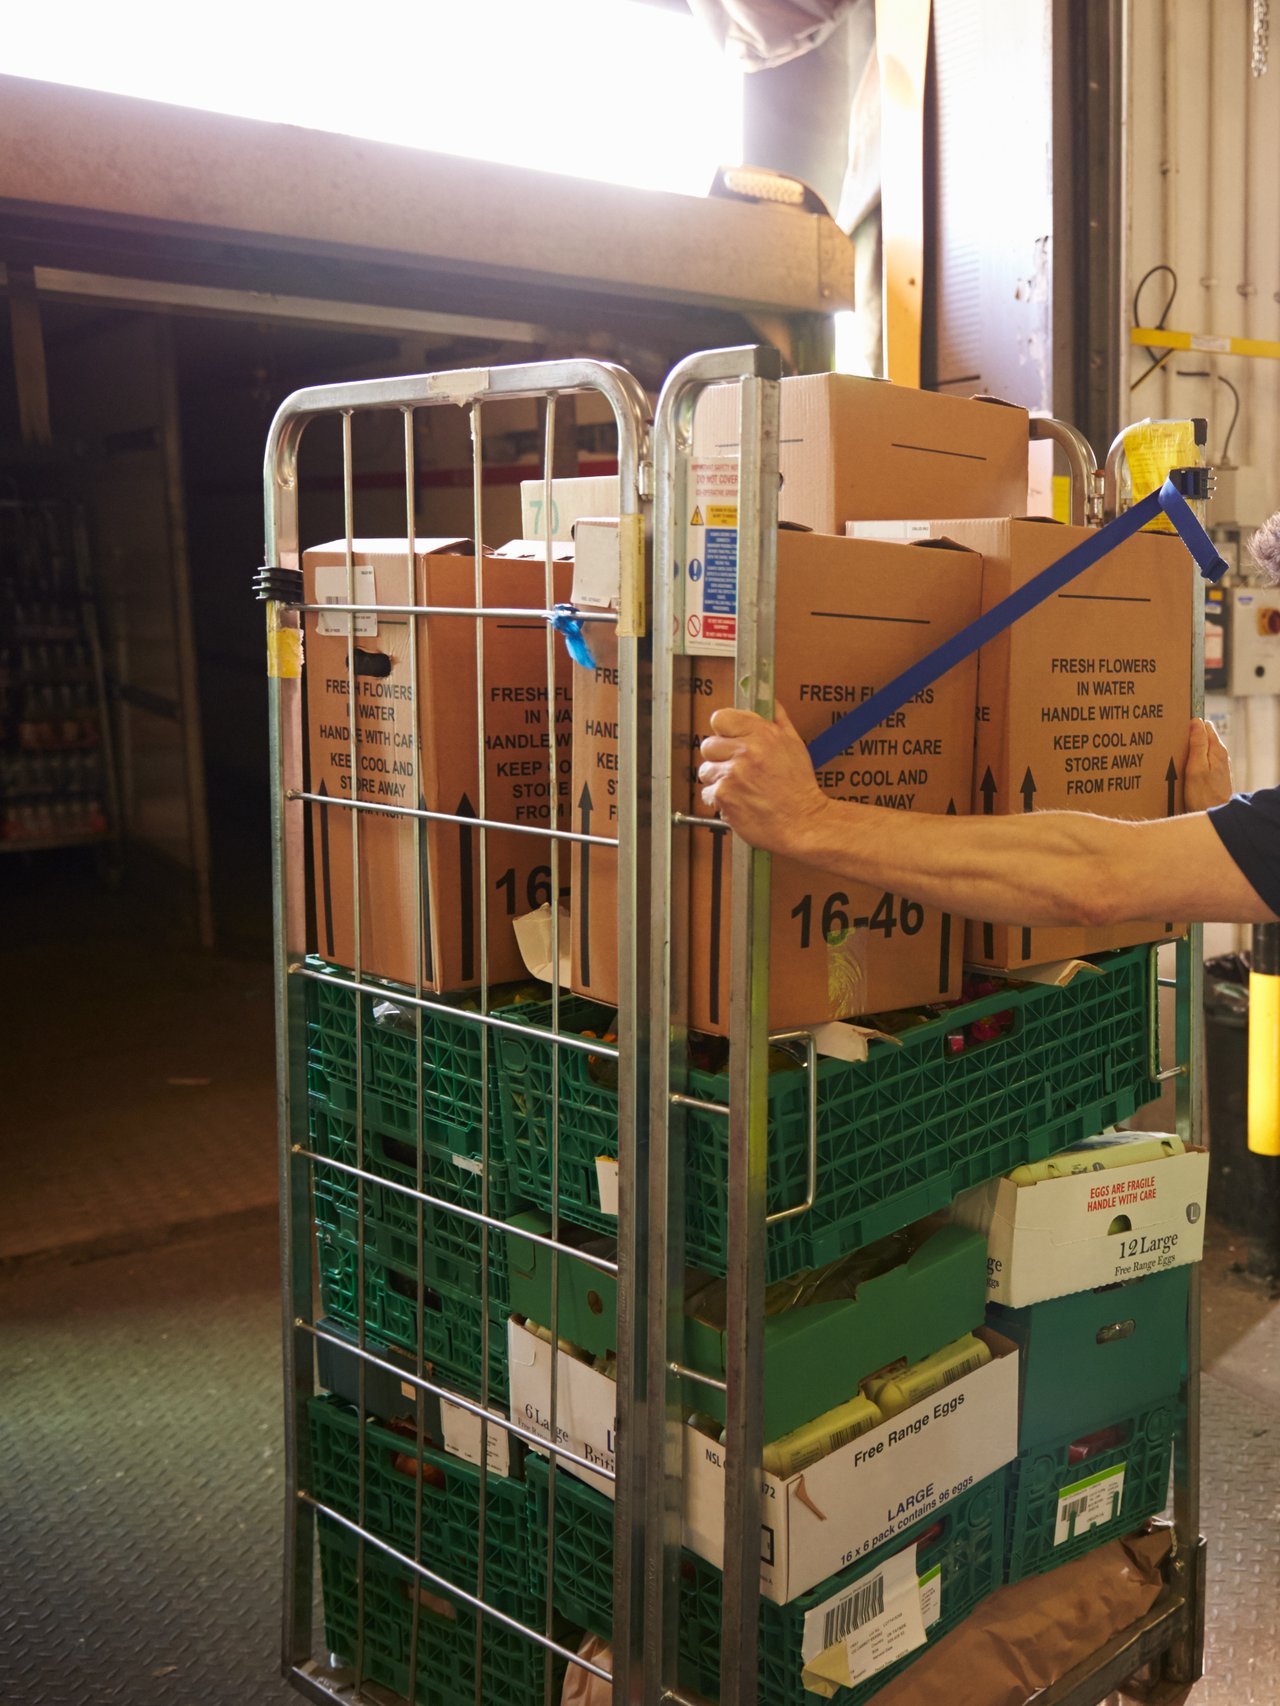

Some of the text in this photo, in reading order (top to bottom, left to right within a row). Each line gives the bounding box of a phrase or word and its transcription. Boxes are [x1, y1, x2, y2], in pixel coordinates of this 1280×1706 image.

[1051, 658, 1157, 673] FRESH FLOWERS
[363, 682, 412, 701] FLOWERS
[491, 687, 548, 702] FRESH
[800, 684, 856, 703] FRESH
[1076, 681, 1135, 696] IN WATER
[359, 704, 395, 721] WATER
[524, 710, 541, 724] IN
[1041, 704, 1164, 722] HANDLE WITH CARE
[320, 725, 362, 743] HANDE
[365, 730, 391, 746] WITH
[1053, 731, 1153, 750] KEEP COOL AND
[859, 739, 898, 756] WITH
[902, 739, 942, 755] CARE
[330, 752, 414, 777] KEE COOL AND
[496, 761, 542, 777] KEEP
[1064, 753, 1144, 773] STORE AWAY
[814, 768, 928, 788] EEP COOL AND
[1066, 775, 1142, 796] FROM FRUIT
[377, 779, 407, 798] AWAY
[512, 781, 569, 799] STOE
[495, 865, 571, 915] 16-
[791, 891, 925, 949] 16-46
[1090, 1176, 1156, 1199] EGGS ARE FRAGILE
[1087, 1188, 1157, 1213] HANDLE WITH CARE
[1119, 1233, 1179, 1260] 12 Large
[1114, 1254, 1176, 1277] Free Range Eggs
[525, 1403, 533, 1420] 6
[535, 1408, 569, 1443] Lage
[854, 1393, 965, 1468] Free Range Eggs
[583, 1442, 615, 1473] Briti
[705, 1449, 721, 1468] NSL
[887, 1483, 934, 1522] LARGE
[841, 1475, 973, 1566] 16 x 6 pack contains 96 eggs
